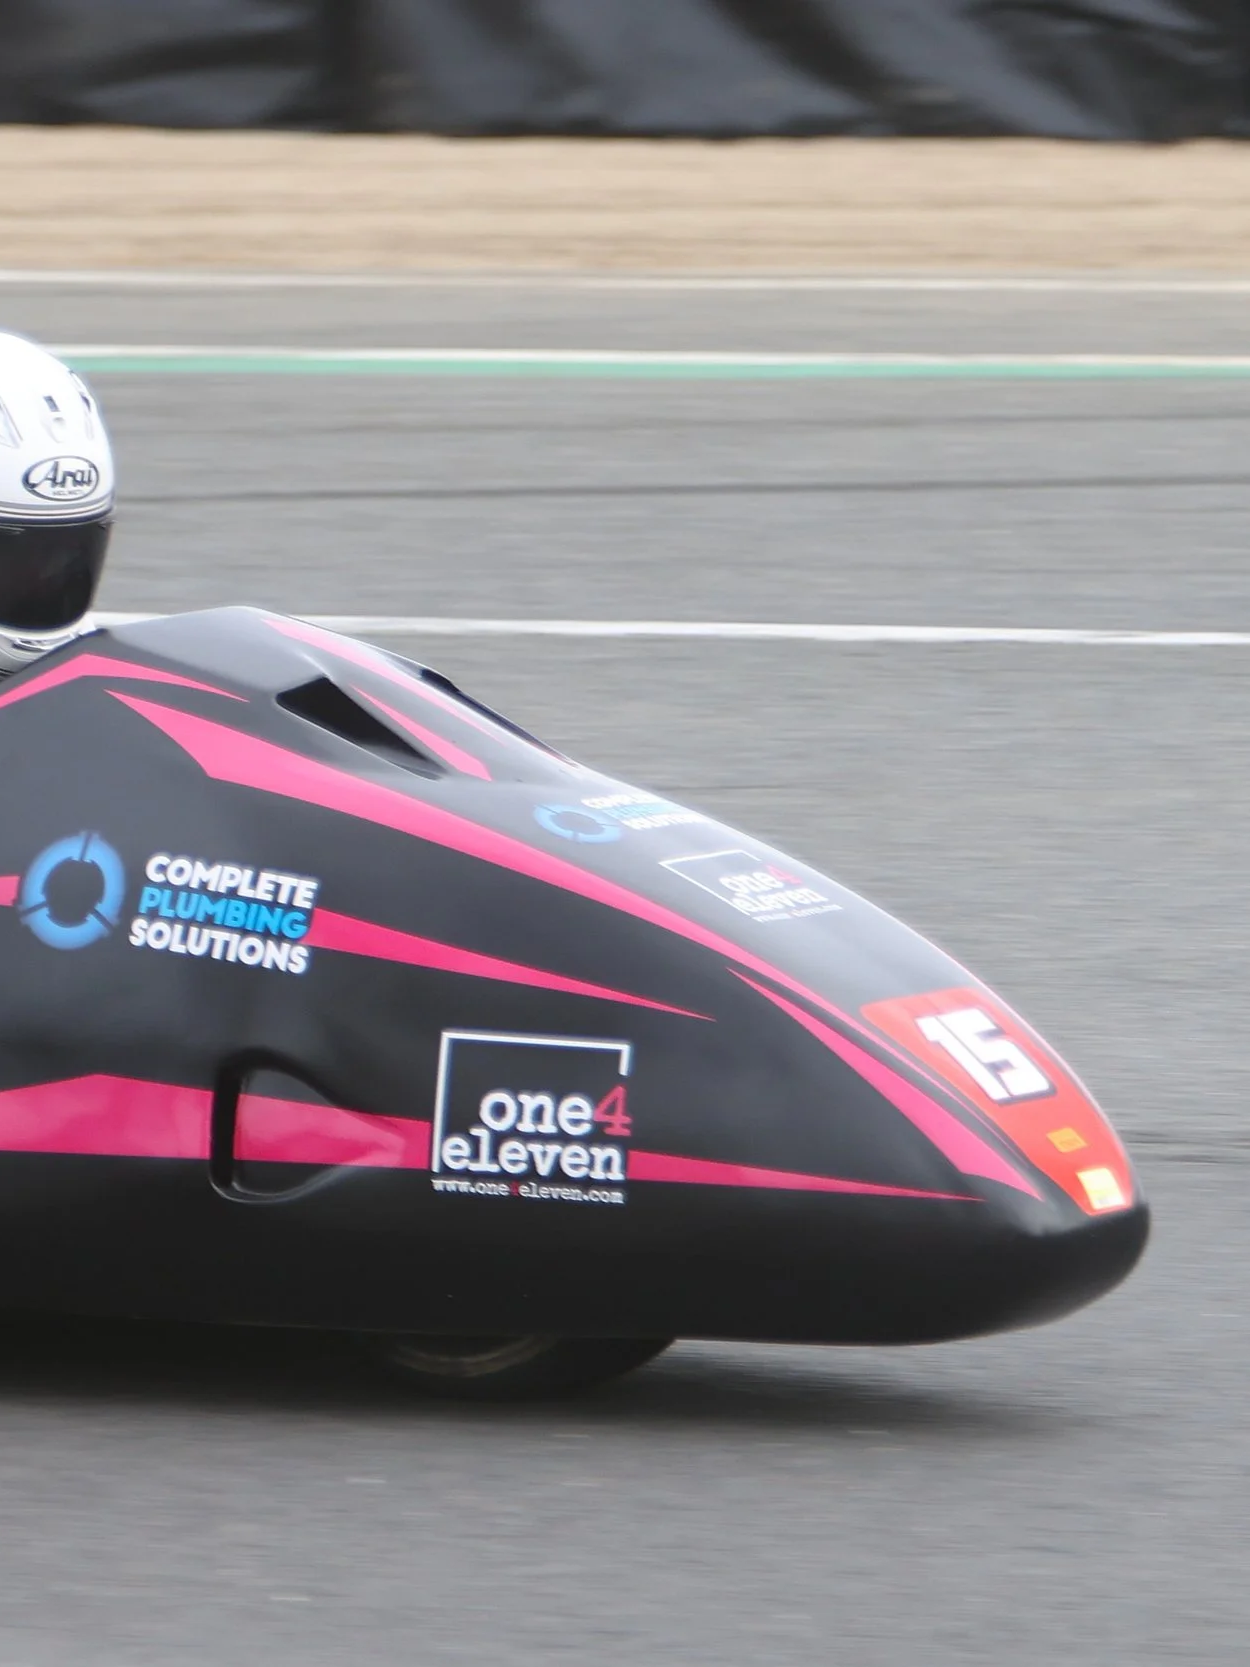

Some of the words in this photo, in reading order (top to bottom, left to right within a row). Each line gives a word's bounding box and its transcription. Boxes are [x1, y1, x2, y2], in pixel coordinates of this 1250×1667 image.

[31, 461, 93, 488] Arai
[144, 854, 319, 910] COMPLETE
[731, 887, 830, 913] eleven
[138, 886, 308, 940] PLUMBING
[128, 918, 311, 975] SOLUTIONS
[915, 1006, 1058, 1105] 15
[478, 1083, 634, 1137] one4
[441, 1126, 626, 1181] eleven
